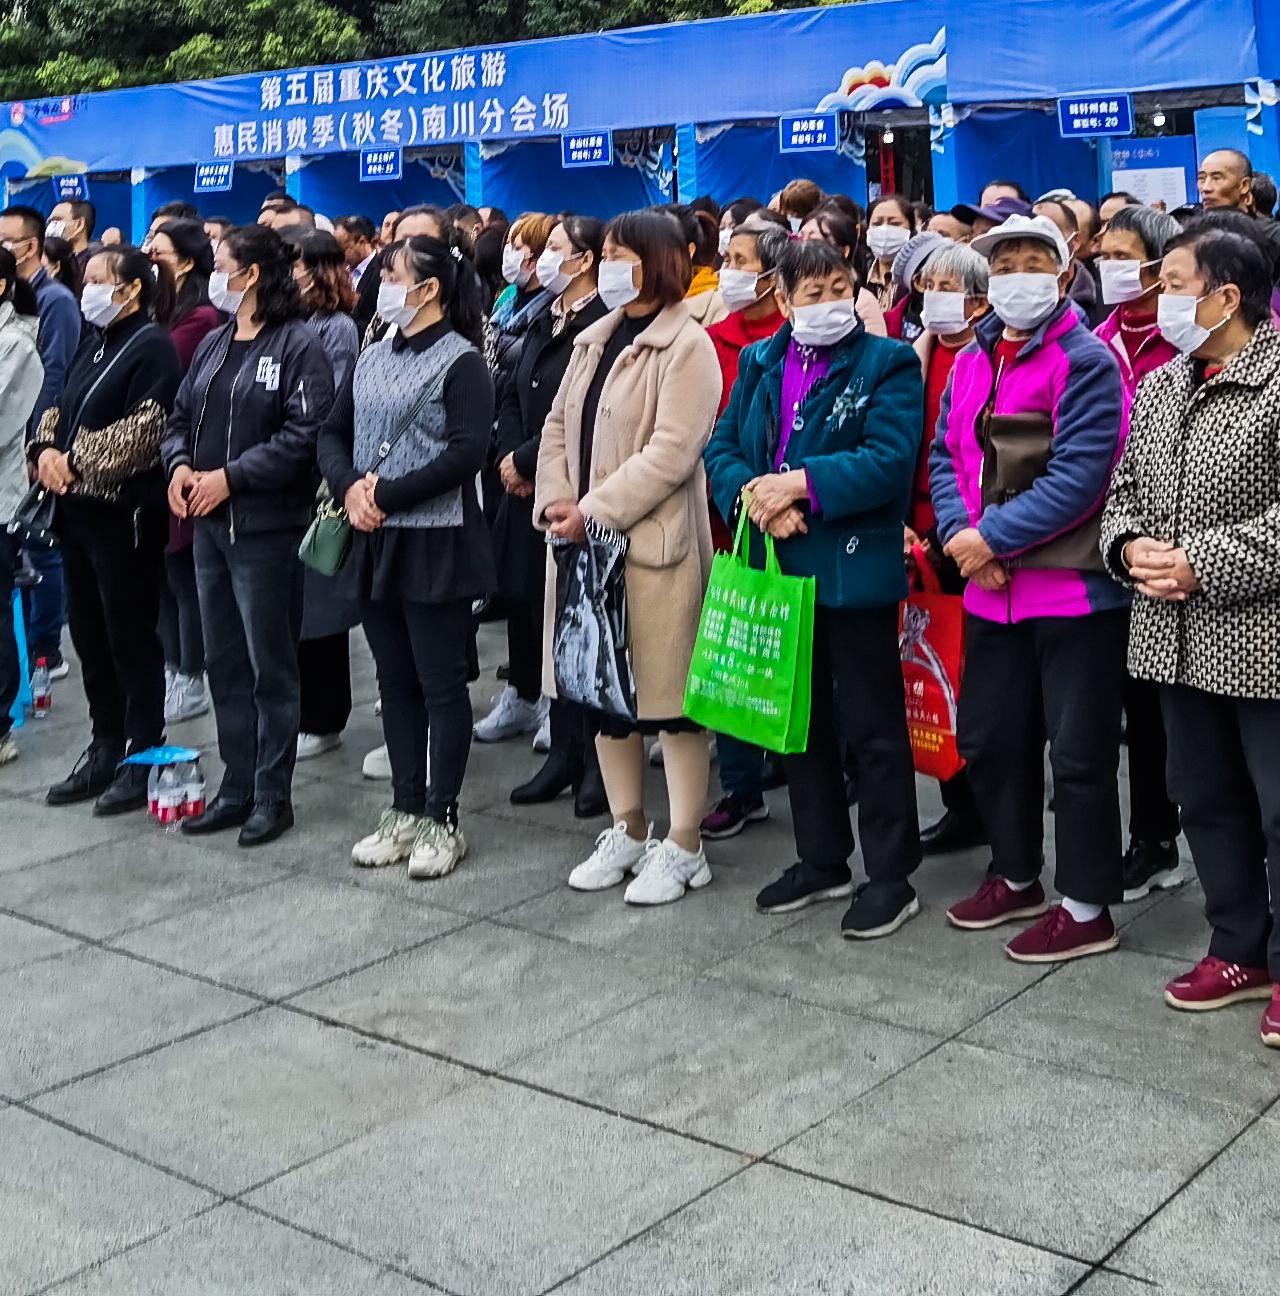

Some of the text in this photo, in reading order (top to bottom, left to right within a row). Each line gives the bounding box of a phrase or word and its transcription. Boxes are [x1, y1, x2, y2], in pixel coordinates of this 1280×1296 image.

[260, 49, 507, 112] 第五届重庆文化旅游
